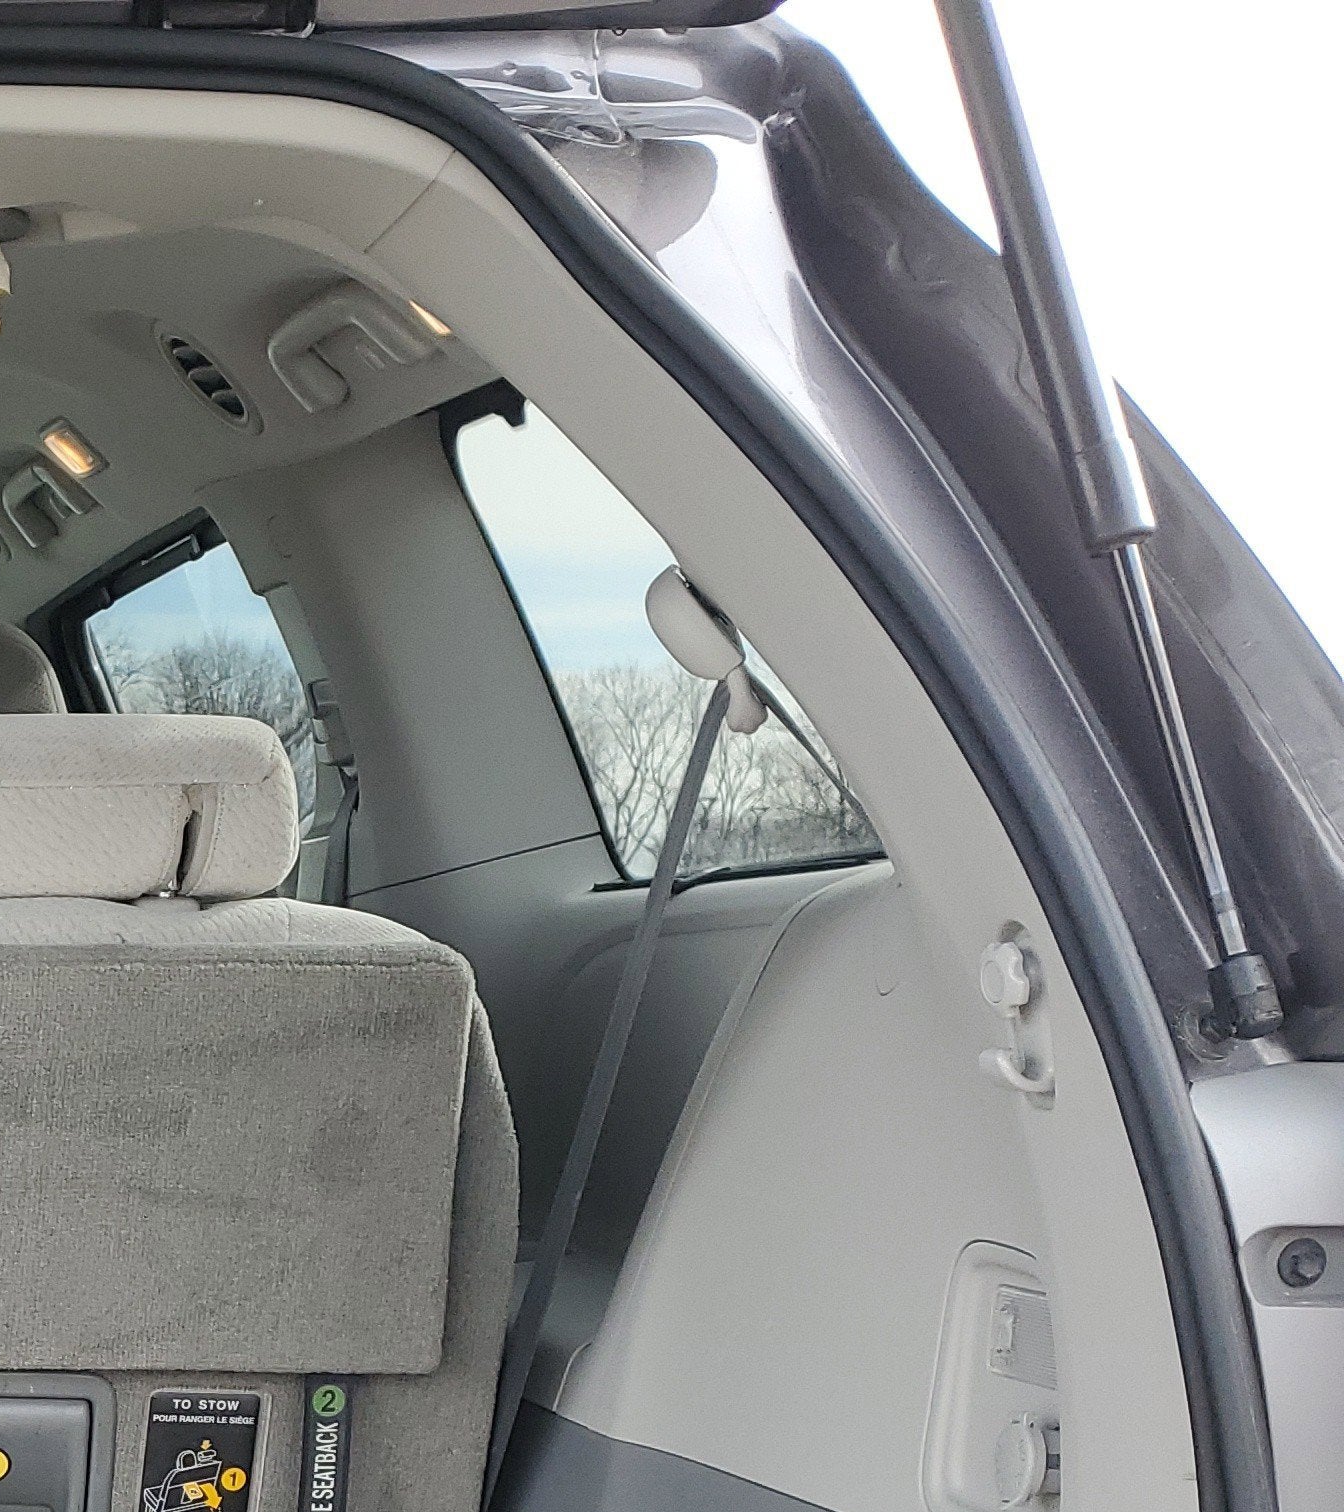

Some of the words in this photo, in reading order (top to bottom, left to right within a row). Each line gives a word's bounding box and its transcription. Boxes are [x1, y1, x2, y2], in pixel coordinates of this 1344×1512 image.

[172, 1398, 192, 1410] TO
[198, 1400, 240, 1411] STOW
[320, 1389, 336, 1412] 2
[153, 1414, 178, 1422] POUR
[179, 1415, 215, 1423] RANGER
[216, 1416, 228, 1424] LE
[311, 1421, 339, 1500] SEATBACK
